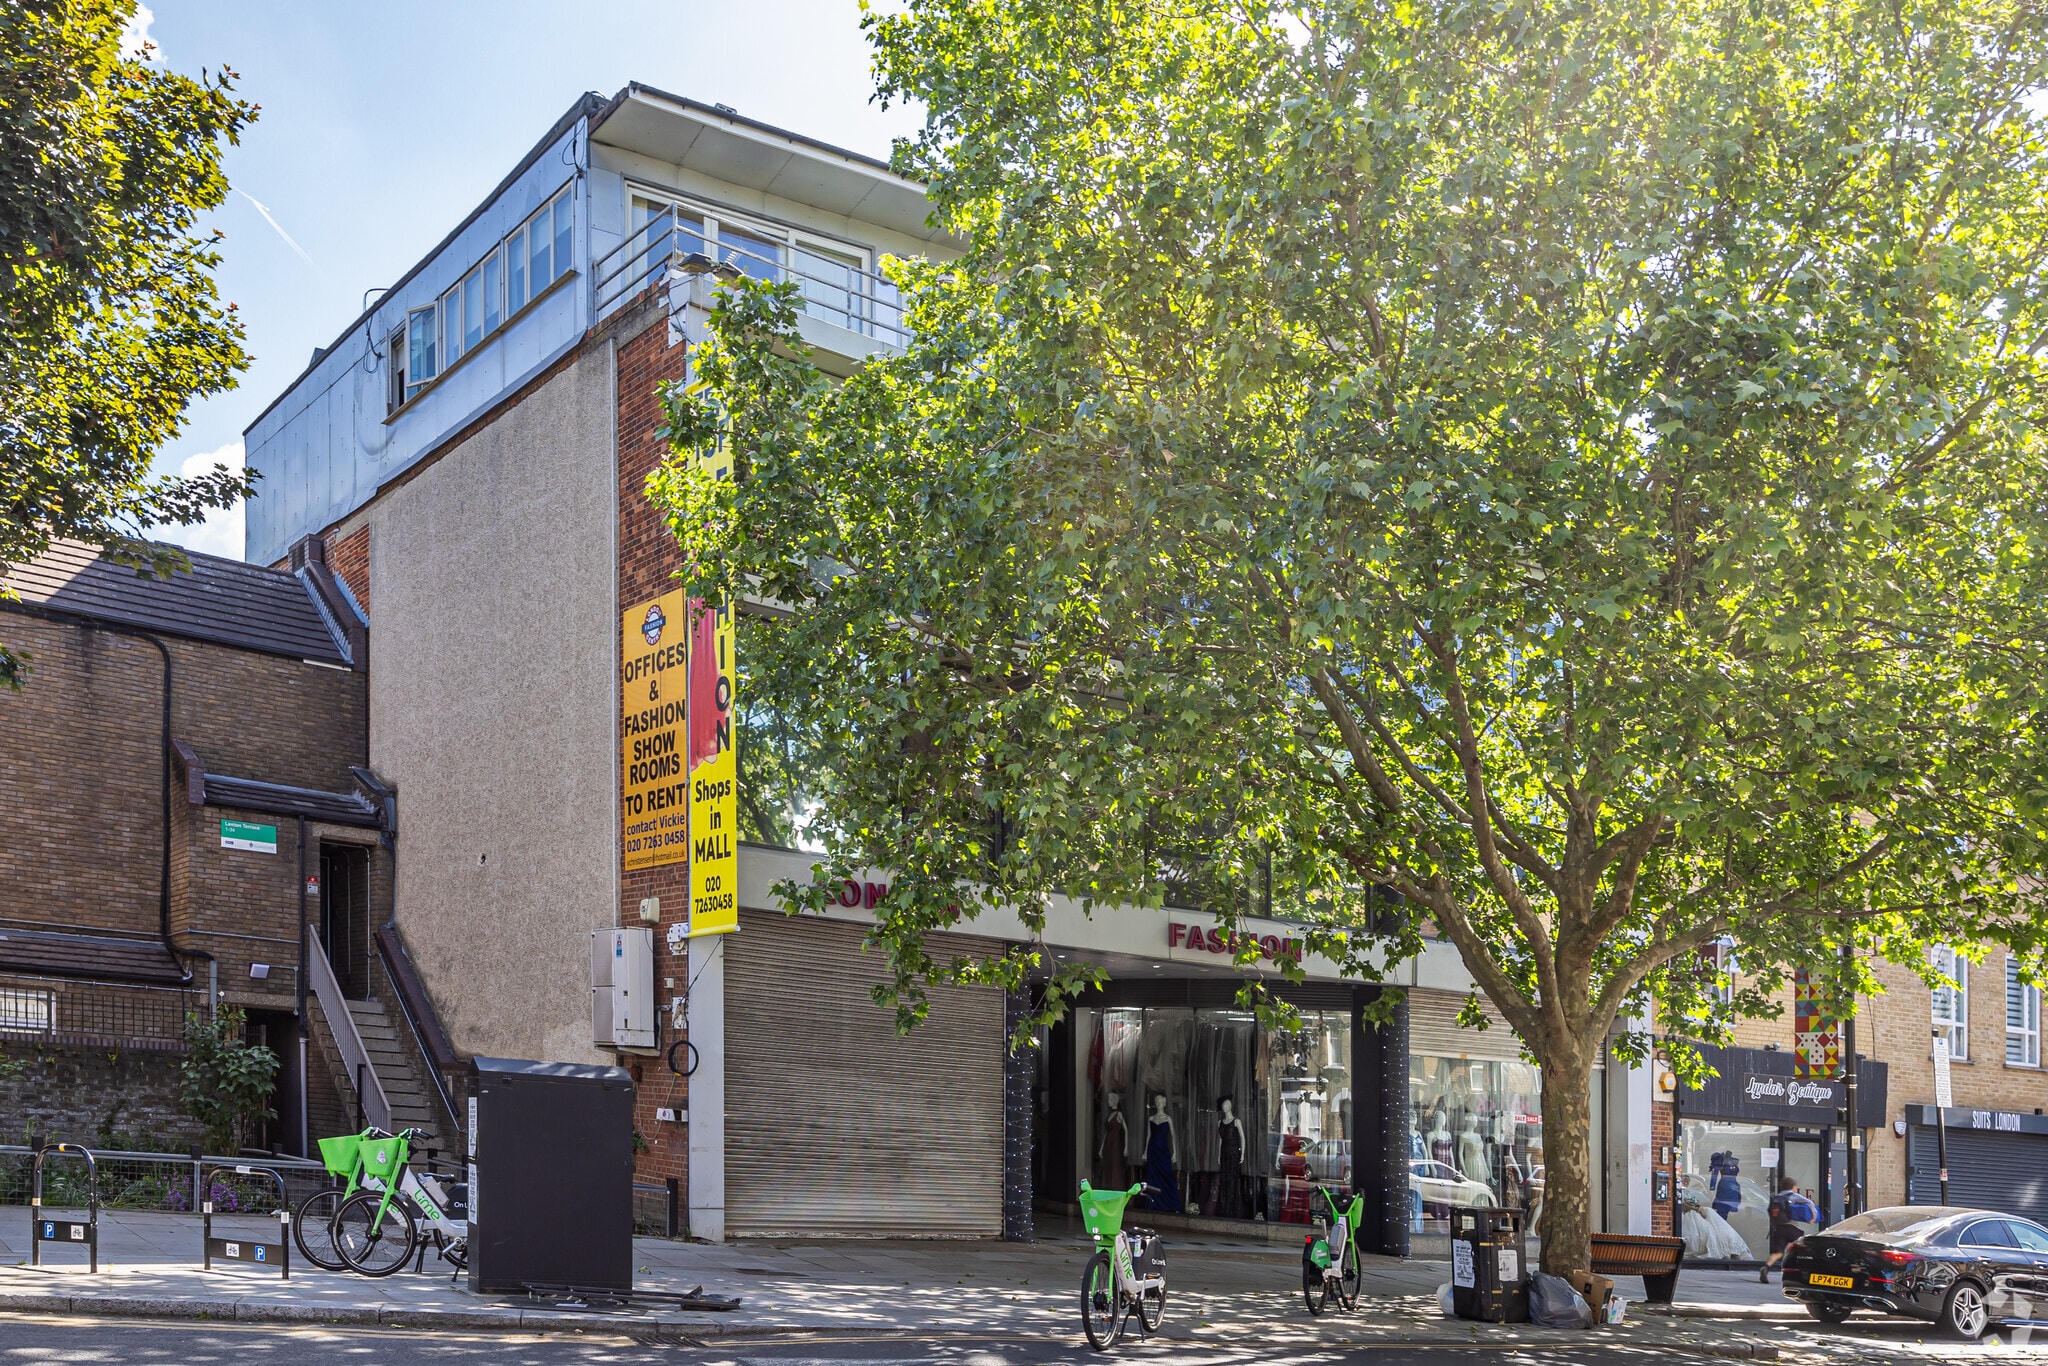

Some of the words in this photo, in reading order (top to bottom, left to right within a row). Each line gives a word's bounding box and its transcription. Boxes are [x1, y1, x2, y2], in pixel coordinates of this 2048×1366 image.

[624, 642, 685, 683] OFFICES
[649, 680, 659, 701] &
[625, 699, 686, 737] FASHION
[633, 730, 676, 761] SHOW
[630, 753, 681, 786] ROOMS
[626, 793, 643, 816] TO
[647, 783, 685, 812] RENT
[695, 779, 731, 803] Shops
[627, 818, 657, 836] contact
[659, 812, 685, 829] Vickie
[709, 805, 722, 830] in
[627, 839, 641, 853] 020
[643, 834, 663, 850] 7263
[664, 830, 685, 847] 0458
[695, 834, 732, 863] MALL
[705, 875, 721, 893] 020
[695, 893, 733, 914] 72630458
[1745, 1076, 1785, 1100] Lynda's
[1787, 1081, 1833, 1106] Boutique
[1972, 1110, 1991, 1130] SUITS
[1995, 1112, 2021, 1132] LONDON
[413, 1188, 441, 1221] Lime
[453, 1201, 464, 1209] On
[1812, 1275, 1832, 1285] LP74
